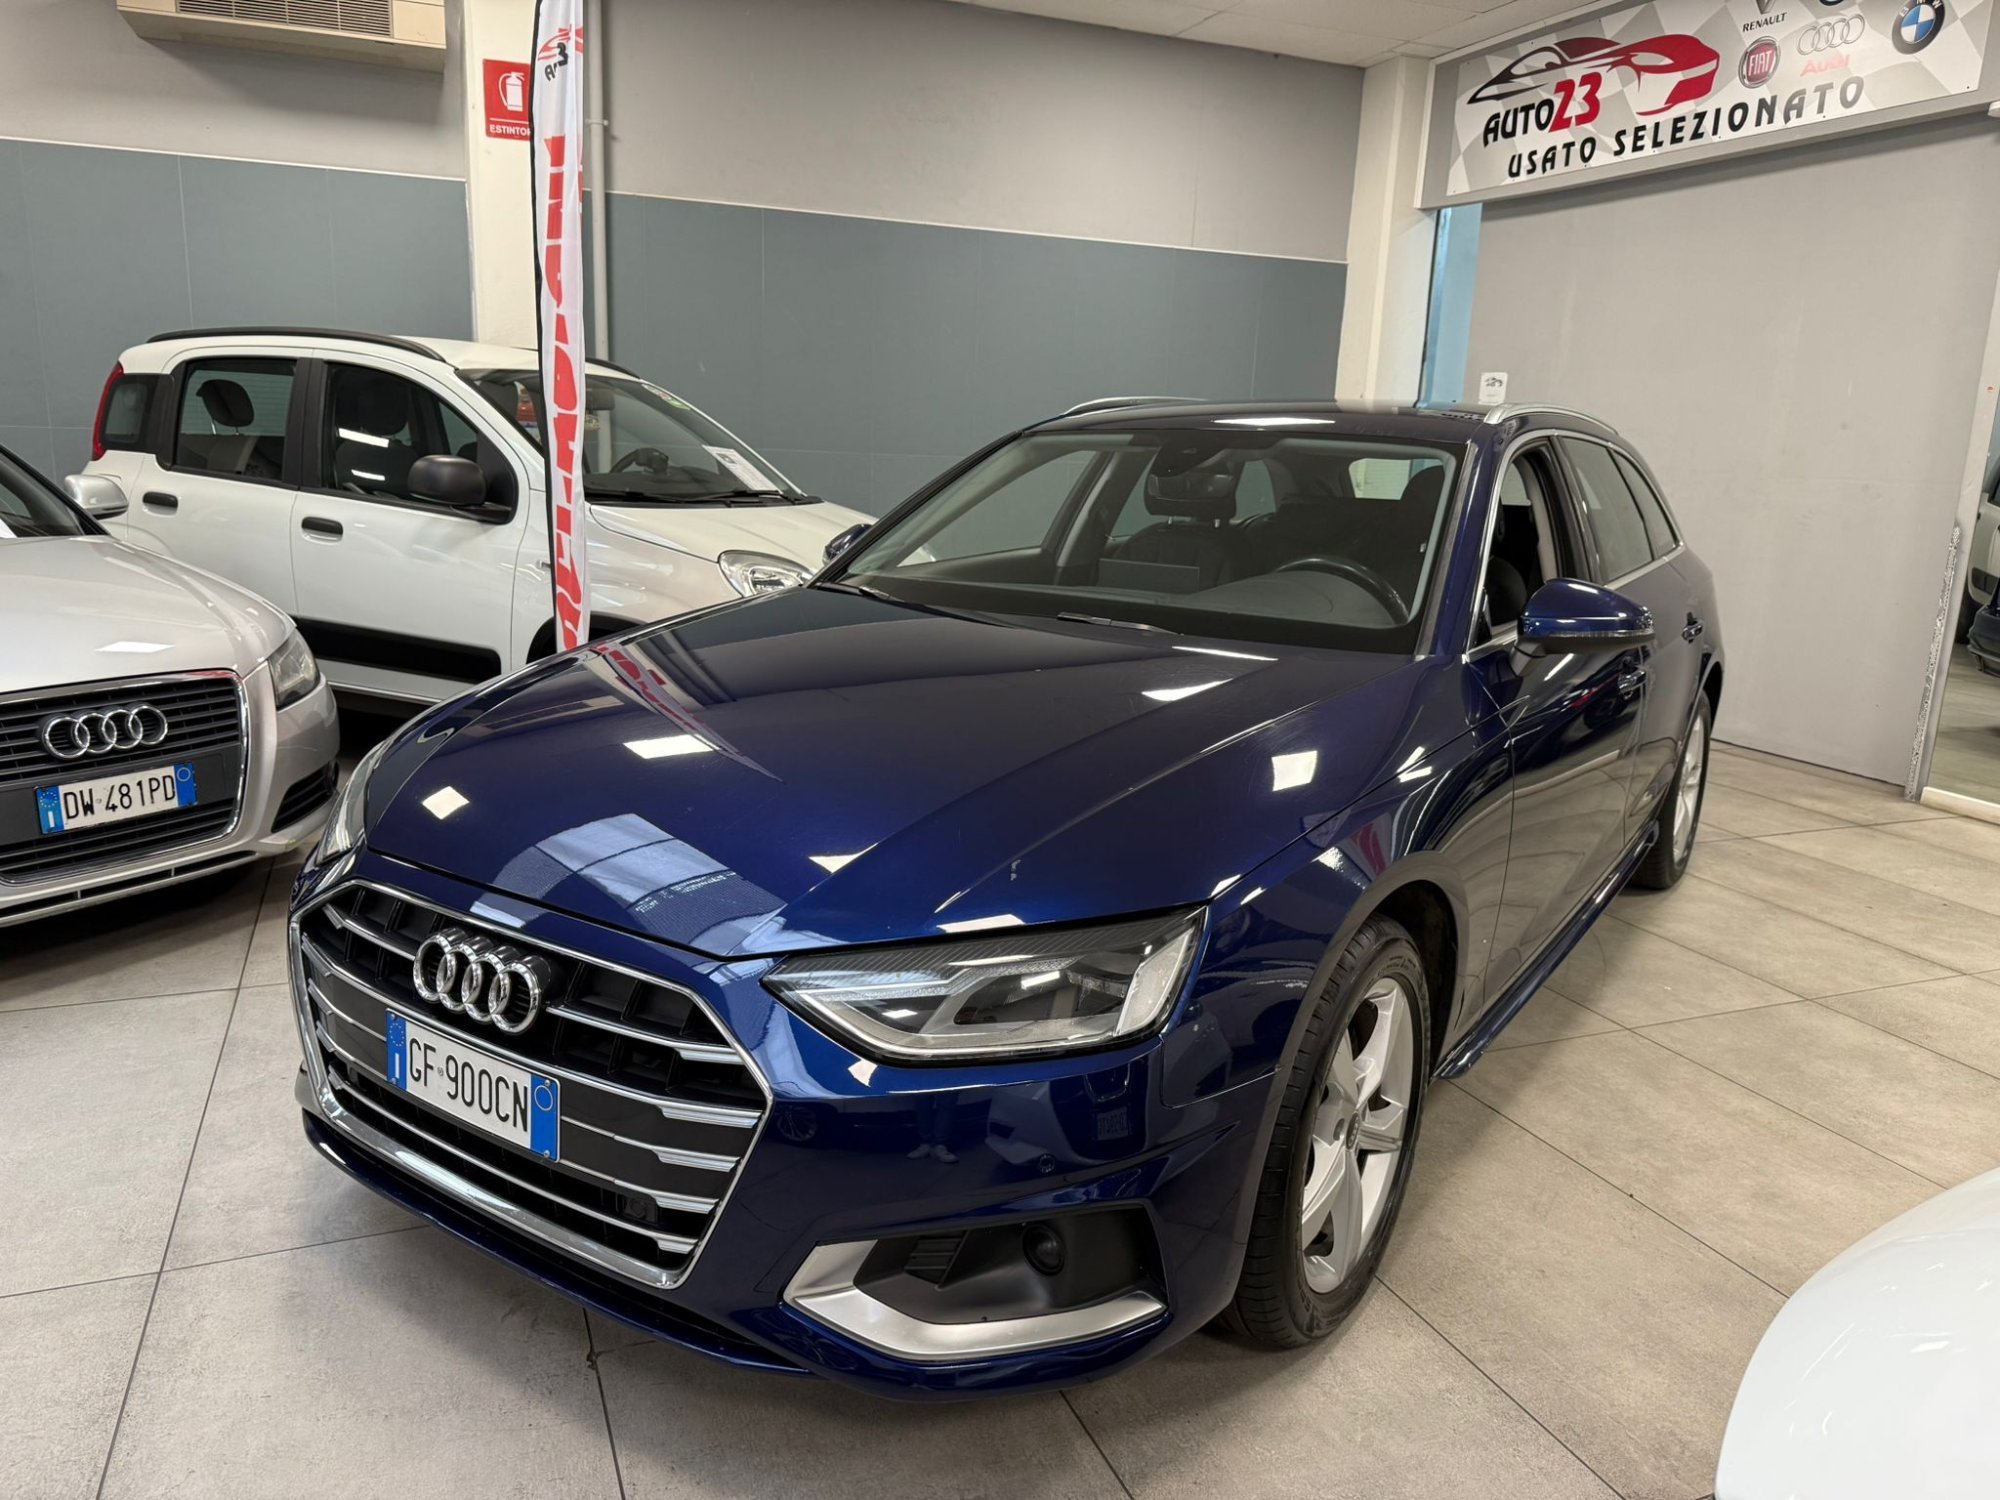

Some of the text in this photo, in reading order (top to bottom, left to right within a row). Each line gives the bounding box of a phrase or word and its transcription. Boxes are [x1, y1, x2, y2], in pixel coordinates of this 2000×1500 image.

[1742, 12, 1787, 33] RENAULT
[1748, 50, 1773, 76] FIAT
[1483, 72, 1602, 148] AUTO23
[489, 124, 531, 136] ESTINTO
[1508, 76, 1864, 178] USATO SELEZIONATO
